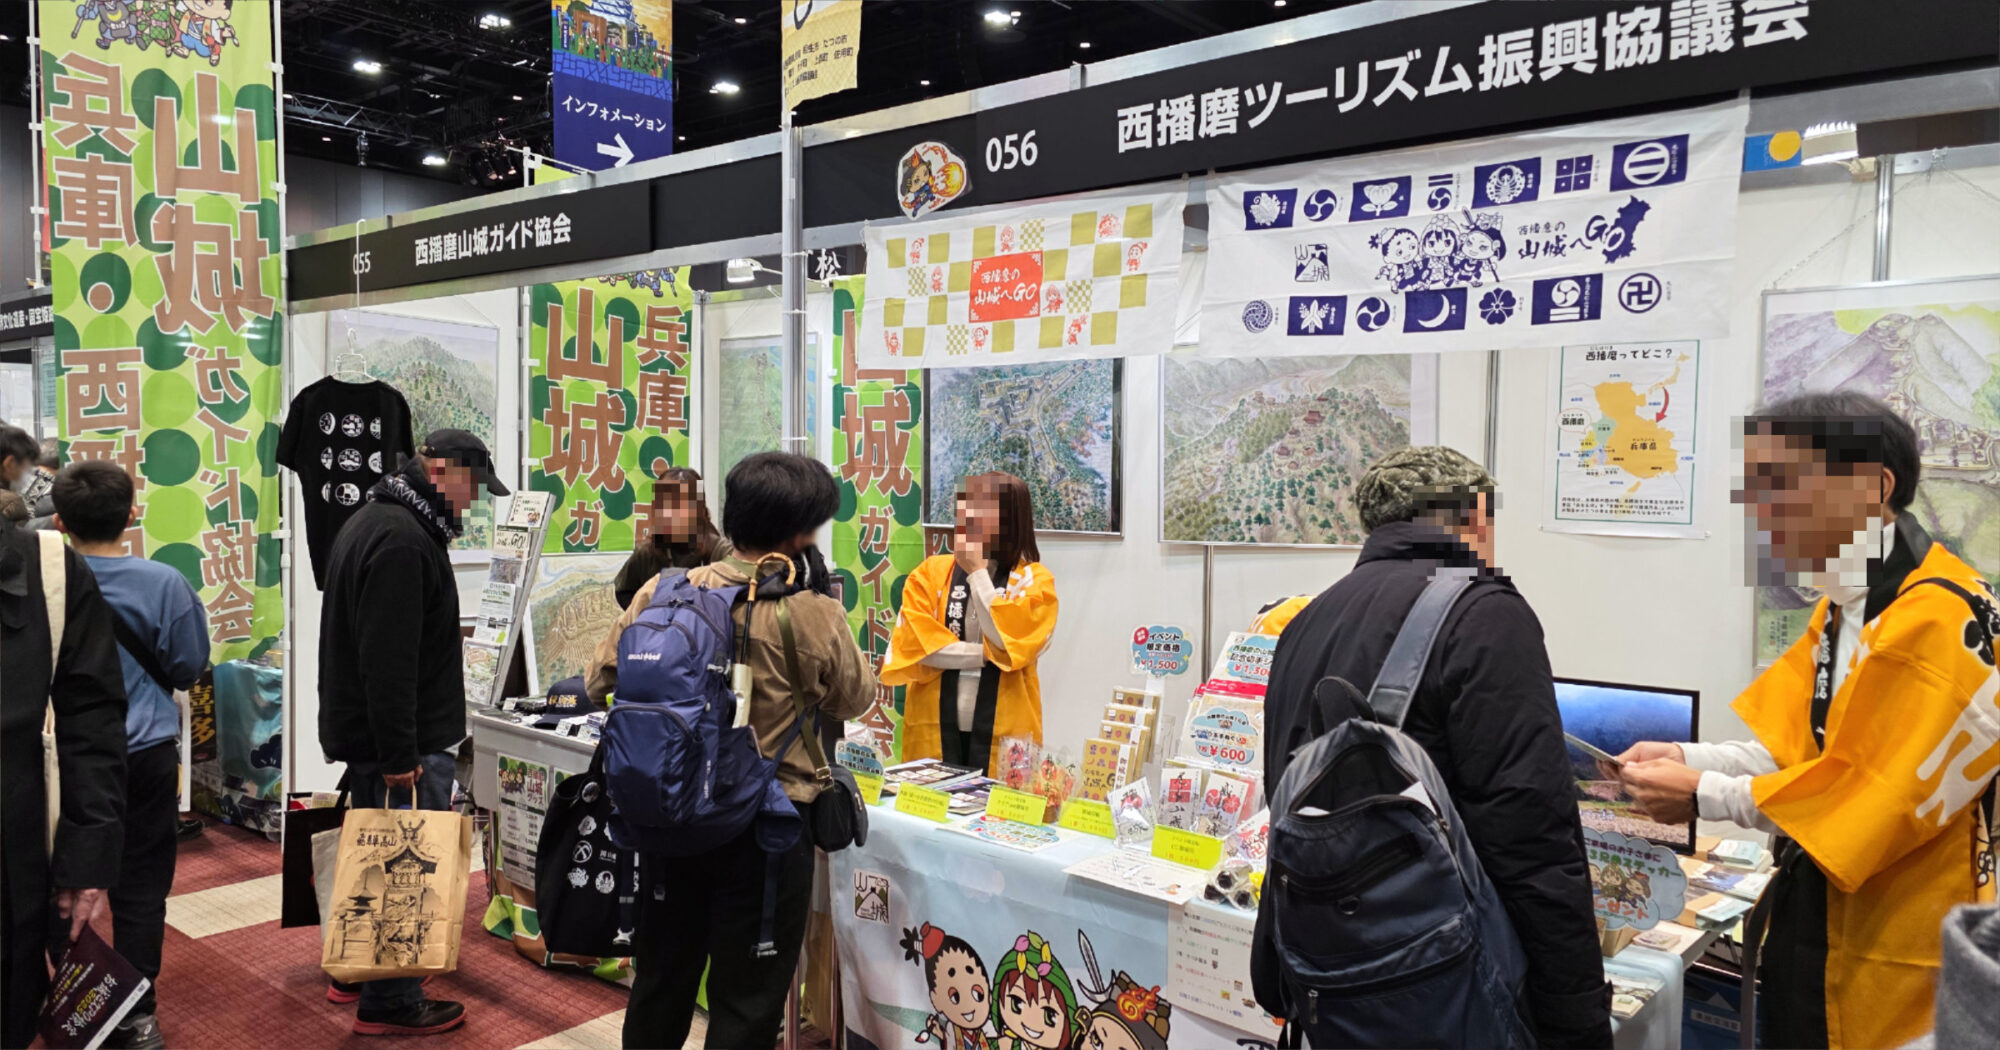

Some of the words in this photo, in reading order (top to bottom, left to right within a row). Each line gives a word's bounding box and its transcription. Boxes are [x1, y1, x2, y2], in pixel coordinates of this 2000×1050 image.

[1117, 0, 1810, 154] 西播磨ツーリズム振興協議会
[561, 95, 667, 133] インフォメーション
[985, 129, 1038, 173] 056
[415, 212, 572, 267] 西播磨山城ガイド協会
[353, 251, 371, 275] 055
[1210, 745, 1246, 762] ¥600
